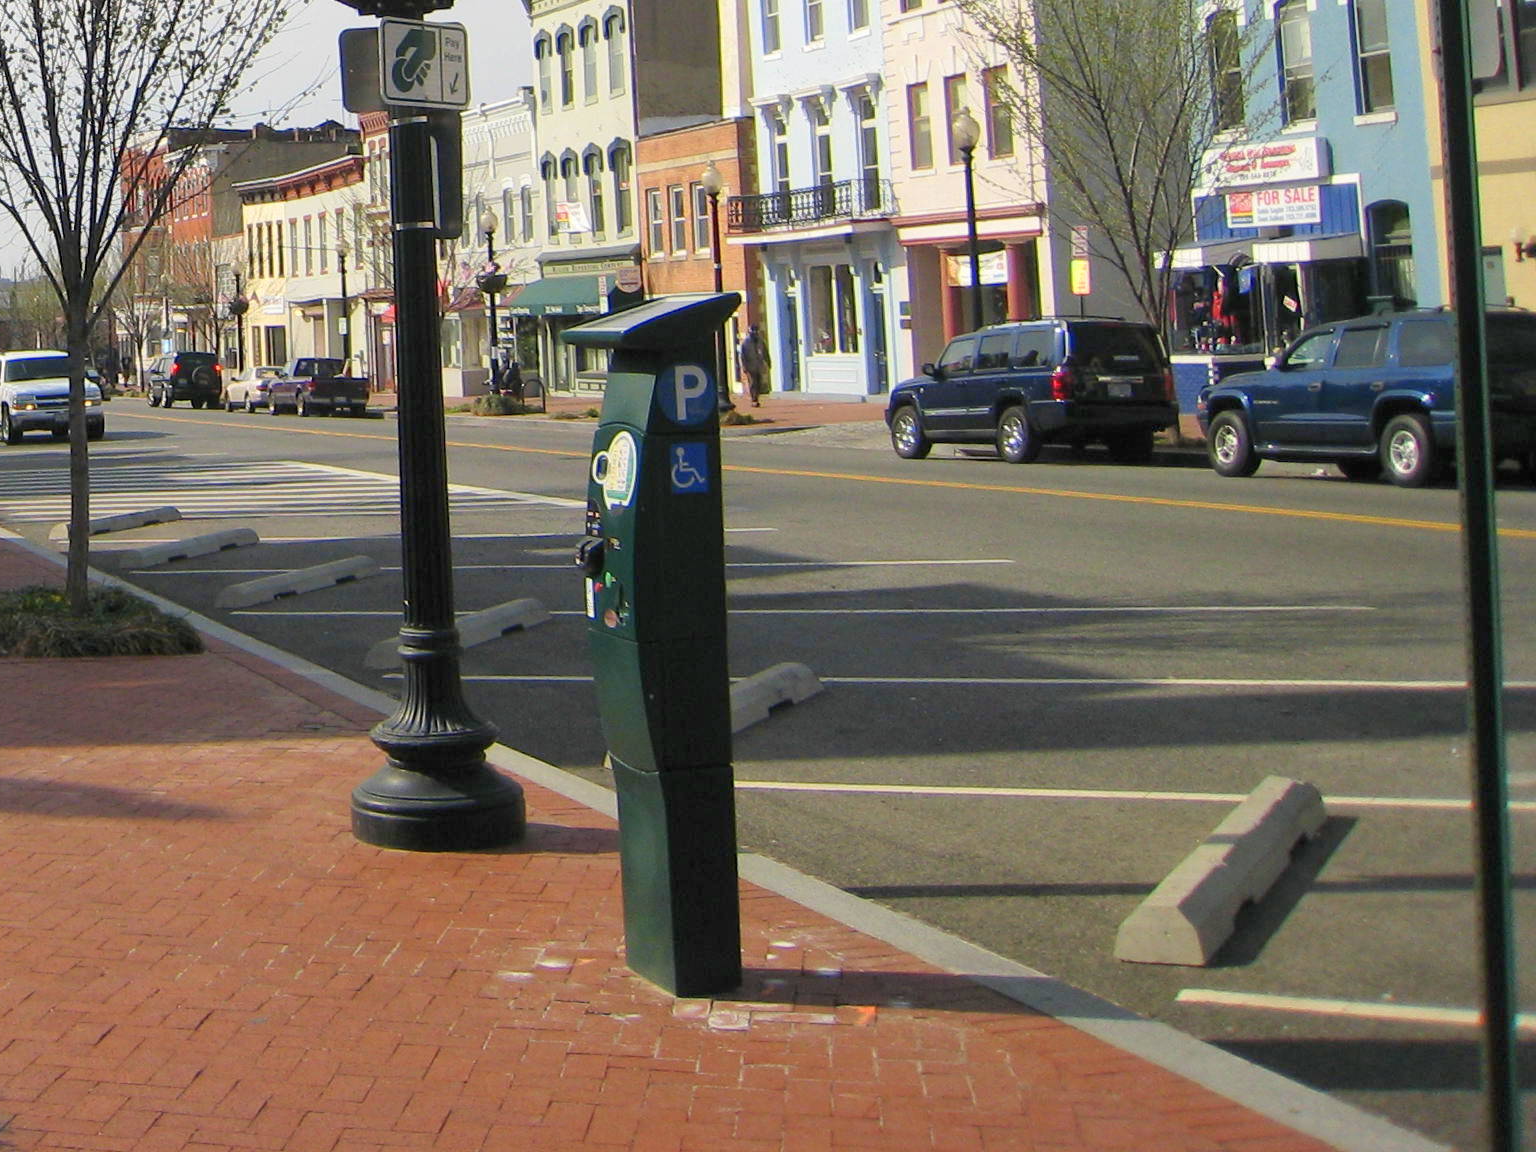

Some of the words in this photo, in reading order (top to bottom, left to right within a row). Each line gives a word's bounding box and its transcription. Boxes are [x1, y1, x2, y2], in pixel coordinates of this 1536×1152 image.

[444, 36, 460, 50] Pay
[444, 52, 463, 64] Here
[1256, 190, 1280, 206] FOR
[1284, 186, 1315, 204] SALE
[675, 365, 708, 420] P
